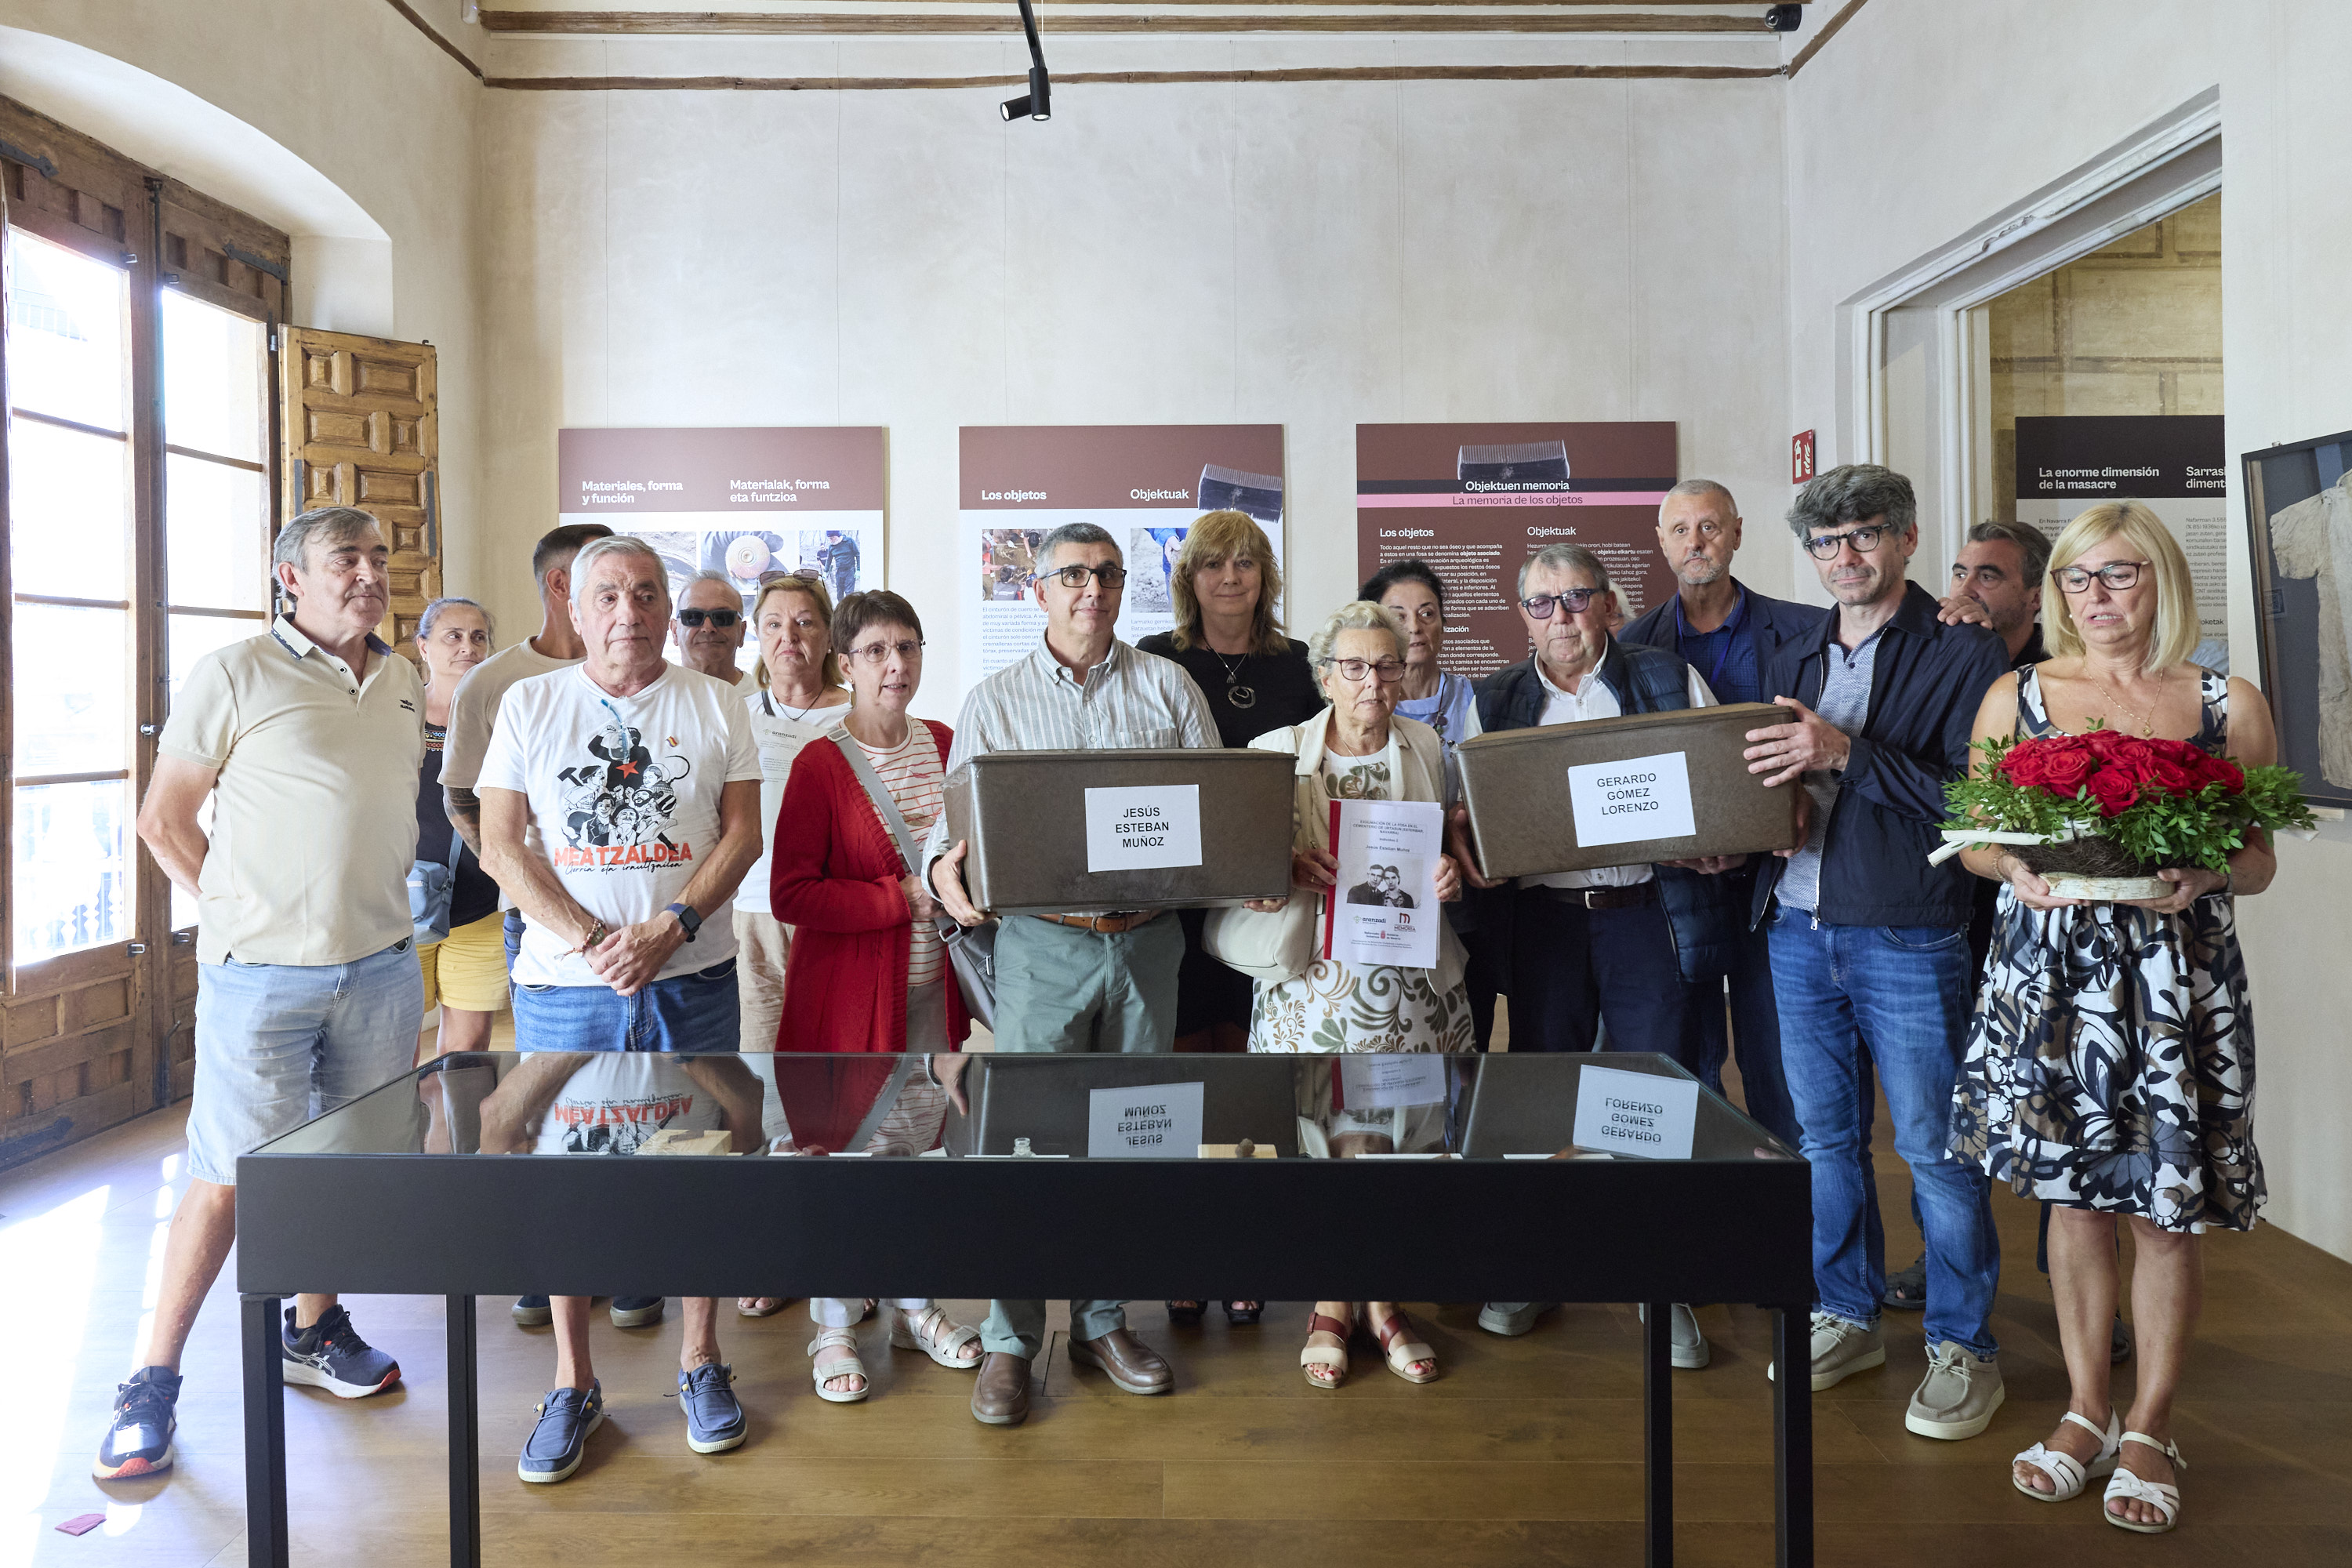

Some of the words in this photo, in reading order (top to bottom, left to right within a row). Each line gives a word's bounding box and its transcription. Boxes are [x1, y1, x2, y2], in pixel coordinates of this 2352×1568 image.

[2039, 468, 2053, 477] La
[2055, 469, 2099, 477] enorme
[2101, 466, 2159, 477] dimensión
[582, 481, 646, 492] Materiales,
[648, 481, 683, 491] forma
[730, 480, 793, 492] Materialak,
[795, 480, 829, 490] forma
[1465, 481, 1520, 492] Objektuen
[1523, 480, 1570, 491] memoria
[2039, 480, 2053, 490] de
[2056, 480, 2065, 489] la
[2186, 478, 2226, 488] diment
[582, 496, 589, 506] y
[592, 494, 635, 503] función
[730, 494, 749, 503] eta
[751, 492, 797, 503] funtzioa
[982, 490, 1003, 500] Los
[1004, 489, 1047, 502] objetos
[1131, 488, 1189, 501] Objektuak
[1453, 495, 1464, 505] La
[1466, 495, 1512, 505] memoria
[1515, 495, 1526, 504] de
[1528, 495, 1544, 504] los
[1545, 494, 1583, 506] objetos
[1380, 528, 1396, 537] Los
[1399, 528, 1434, 539] objetos
[1527, 527, 1577, 538] Objektuak
[772, 731, 797, 739] aranzadi
[1597, 773, 1657, 788] GERARDO
[1607, 788, 1650, 800] GÓMEZ
[1123, 805, 1160, 818] JESÚS
[1602, 801, 1659, 815] LORENZO
[1116, 822, 1169, 833] ESTEBAN
[1123, 836, 1164, 848] MUÑOZ
[554, 843, 693, 866] MEATZALDEA
[601, 863, 617, 875] eta
